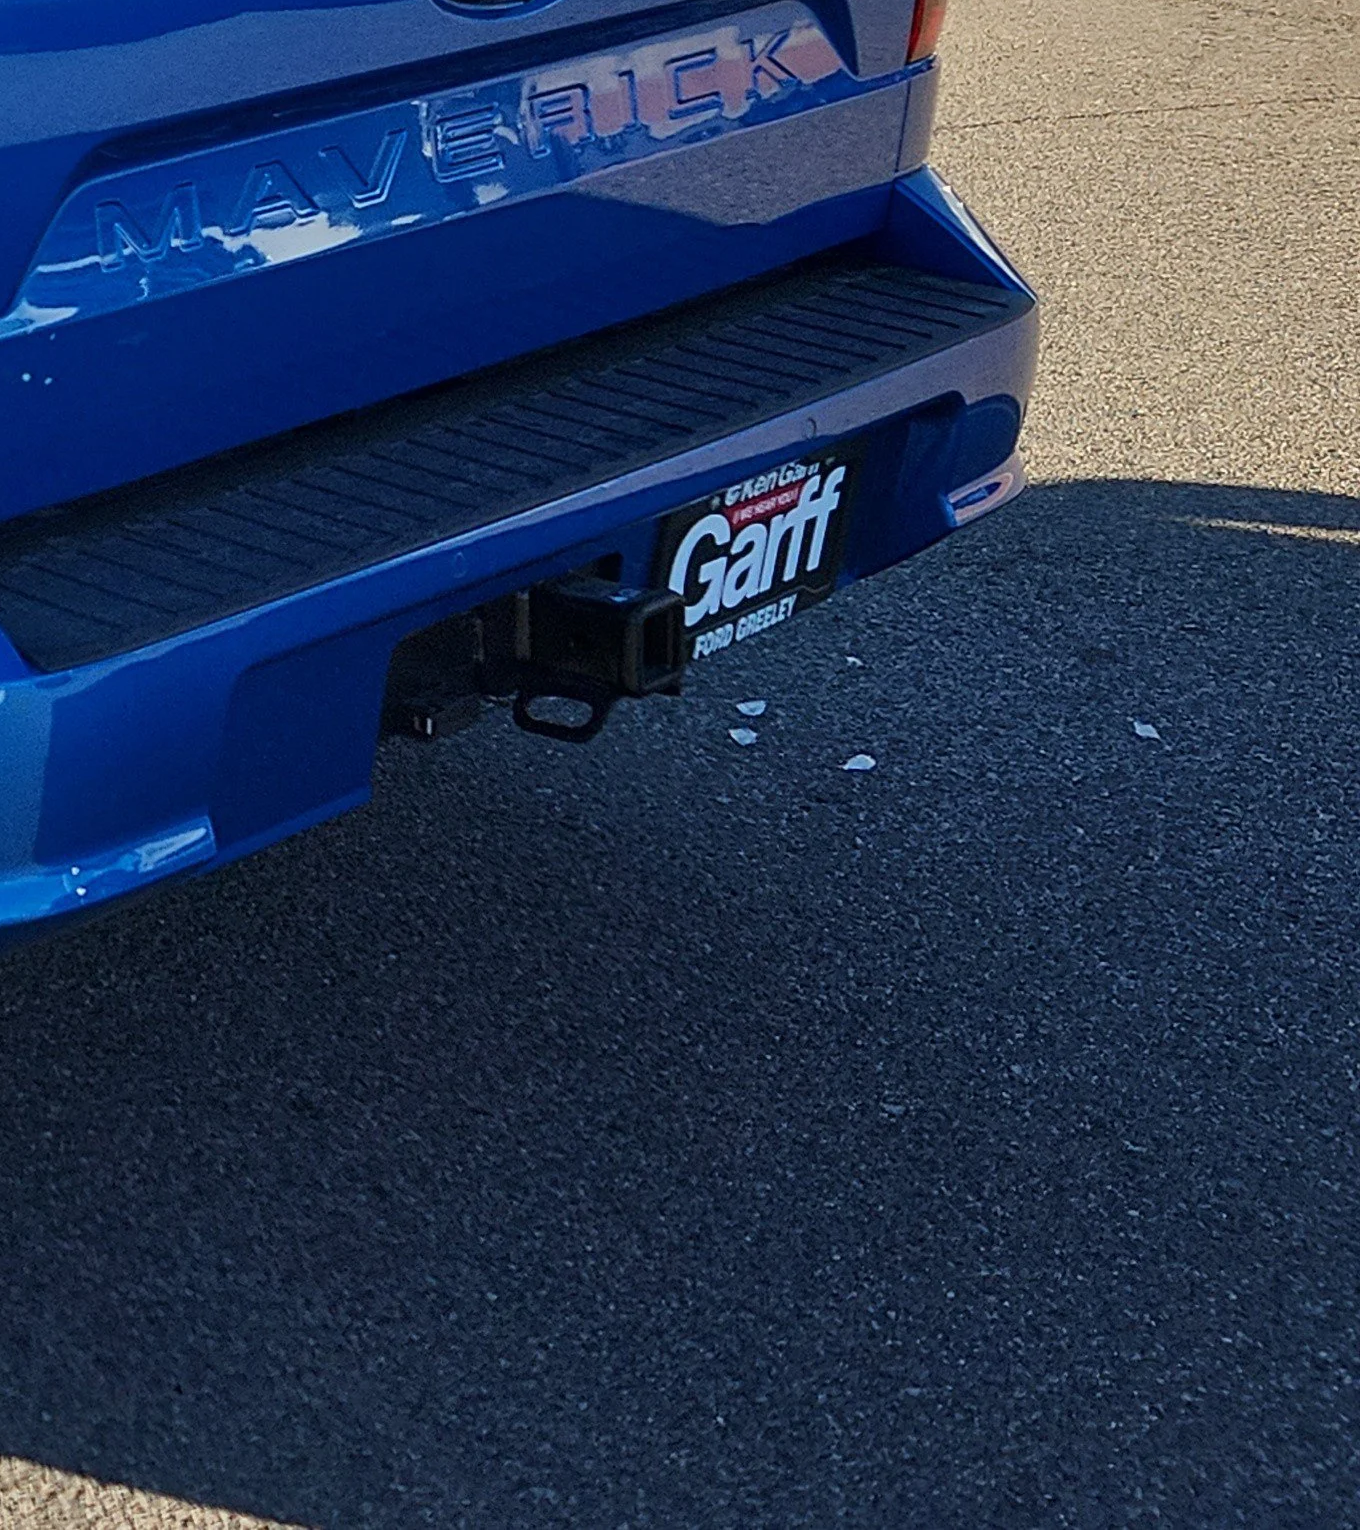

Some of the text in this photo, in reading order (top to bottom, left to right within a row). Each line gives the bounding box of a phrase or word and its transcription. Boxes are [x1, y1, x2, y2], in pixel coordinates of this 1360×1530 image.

[93, 27, 804, 274] MAVERICK
[669, 465, 846, 626] Garff
[692, 593, 798, 660] FORD GREELEY
